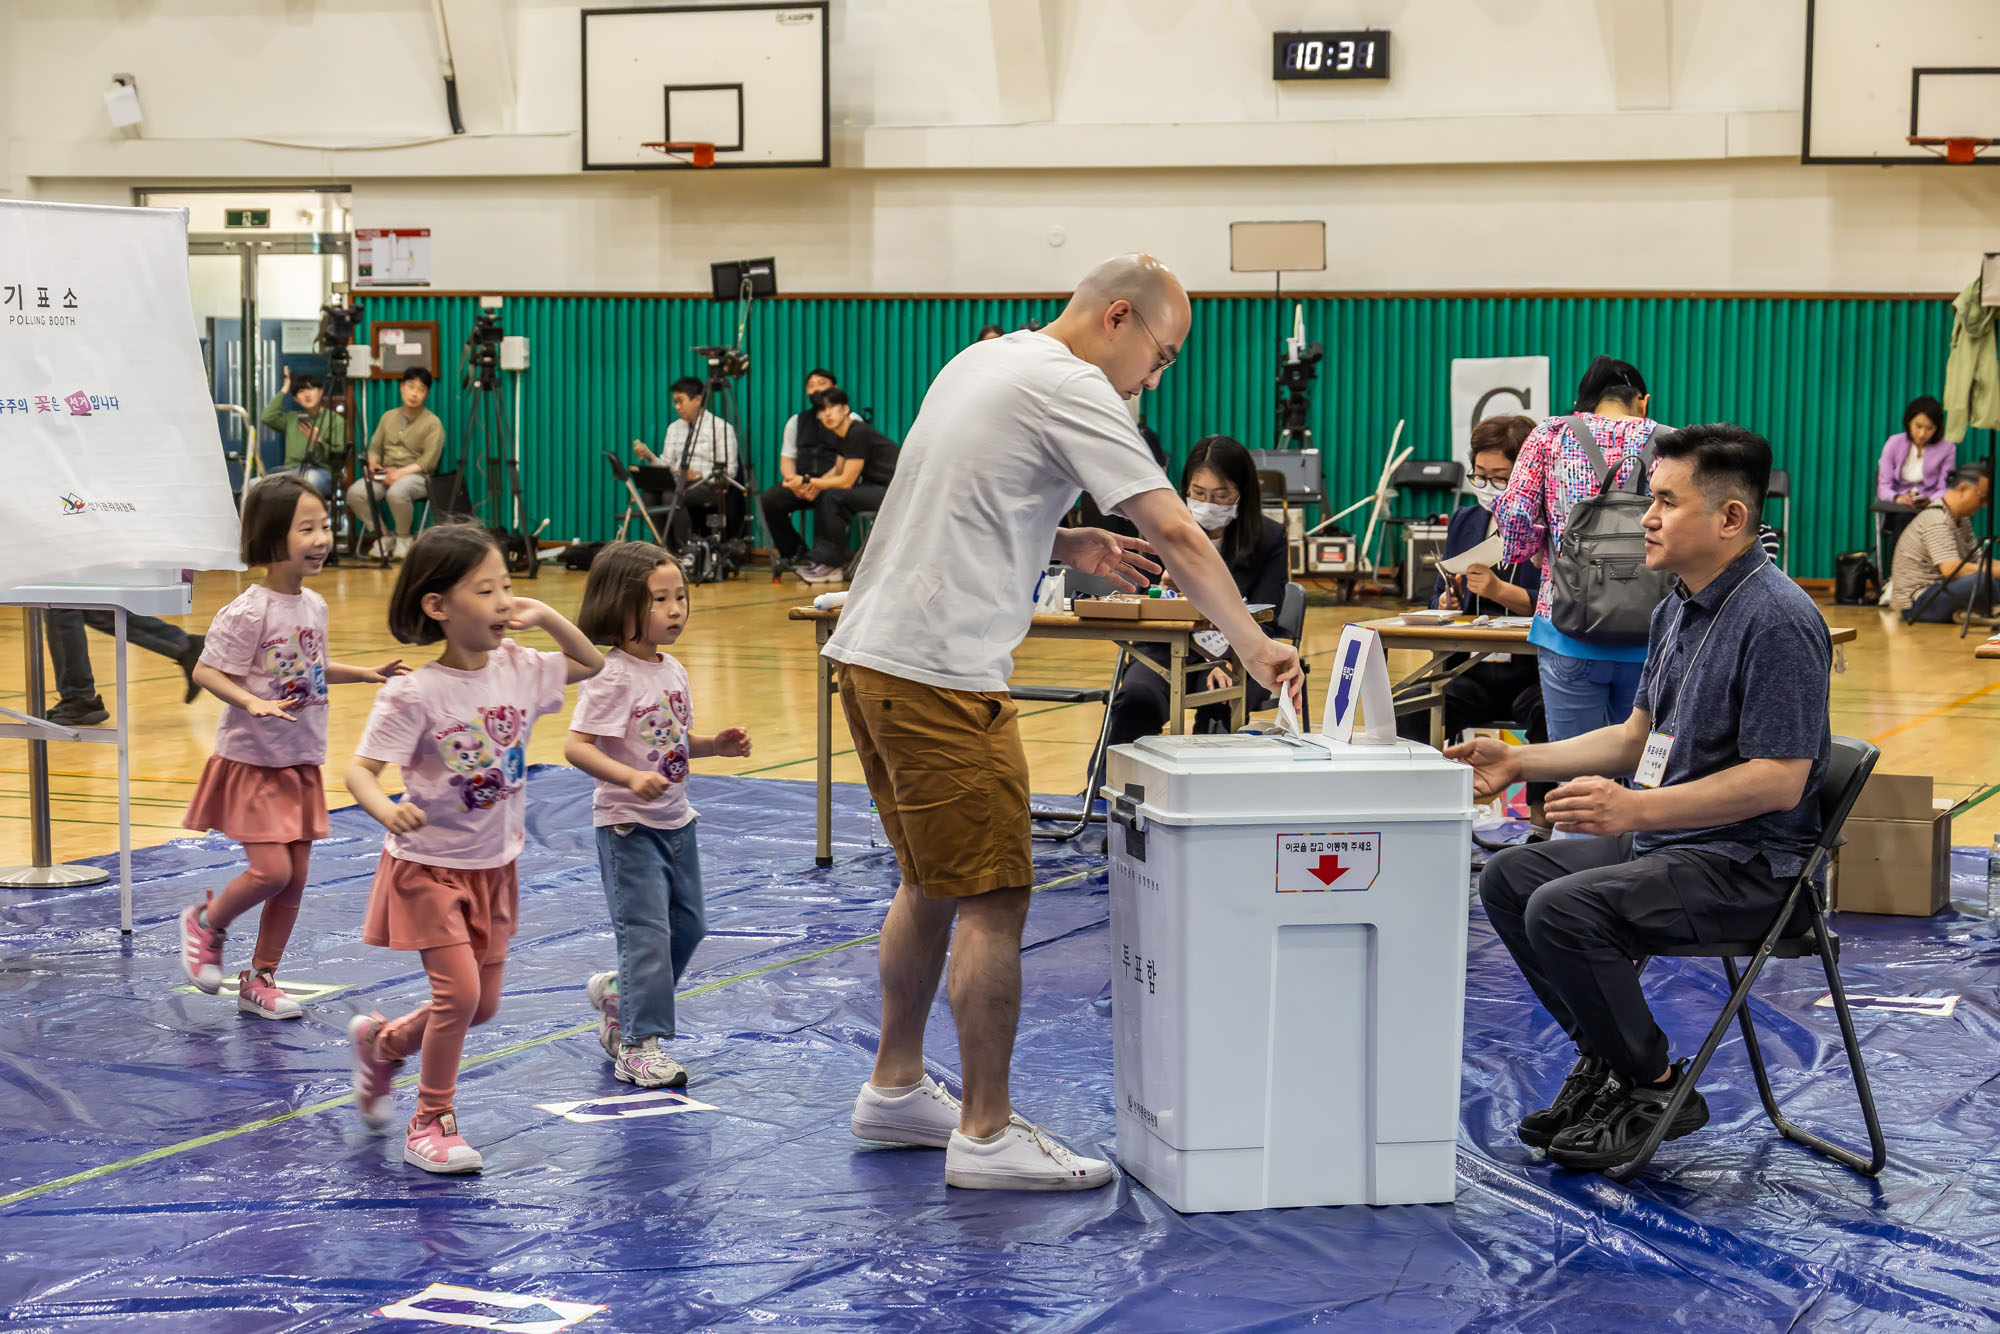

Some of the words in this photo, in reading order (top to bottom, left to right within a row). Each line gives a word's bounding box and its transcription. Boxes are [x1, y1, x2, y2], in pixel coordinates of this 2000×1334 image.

[1296, 41, 1374, 71] 10:31
[4, 284, 78, 310] 기표소
[9, 315, 46, 325] POLLING
[49, 316, 76, 326] BOOTH
[34, 395, 60, 413] 꽃은
[1285, 842, 1307, 853] 이곳을
[1310, 842, 1324, 853] 잡고
[1327, 842, 1348, 852] 이동해
[1351, 841, 1372, 852] 주세요
[1122, 944, 1156, 995] 투표함
